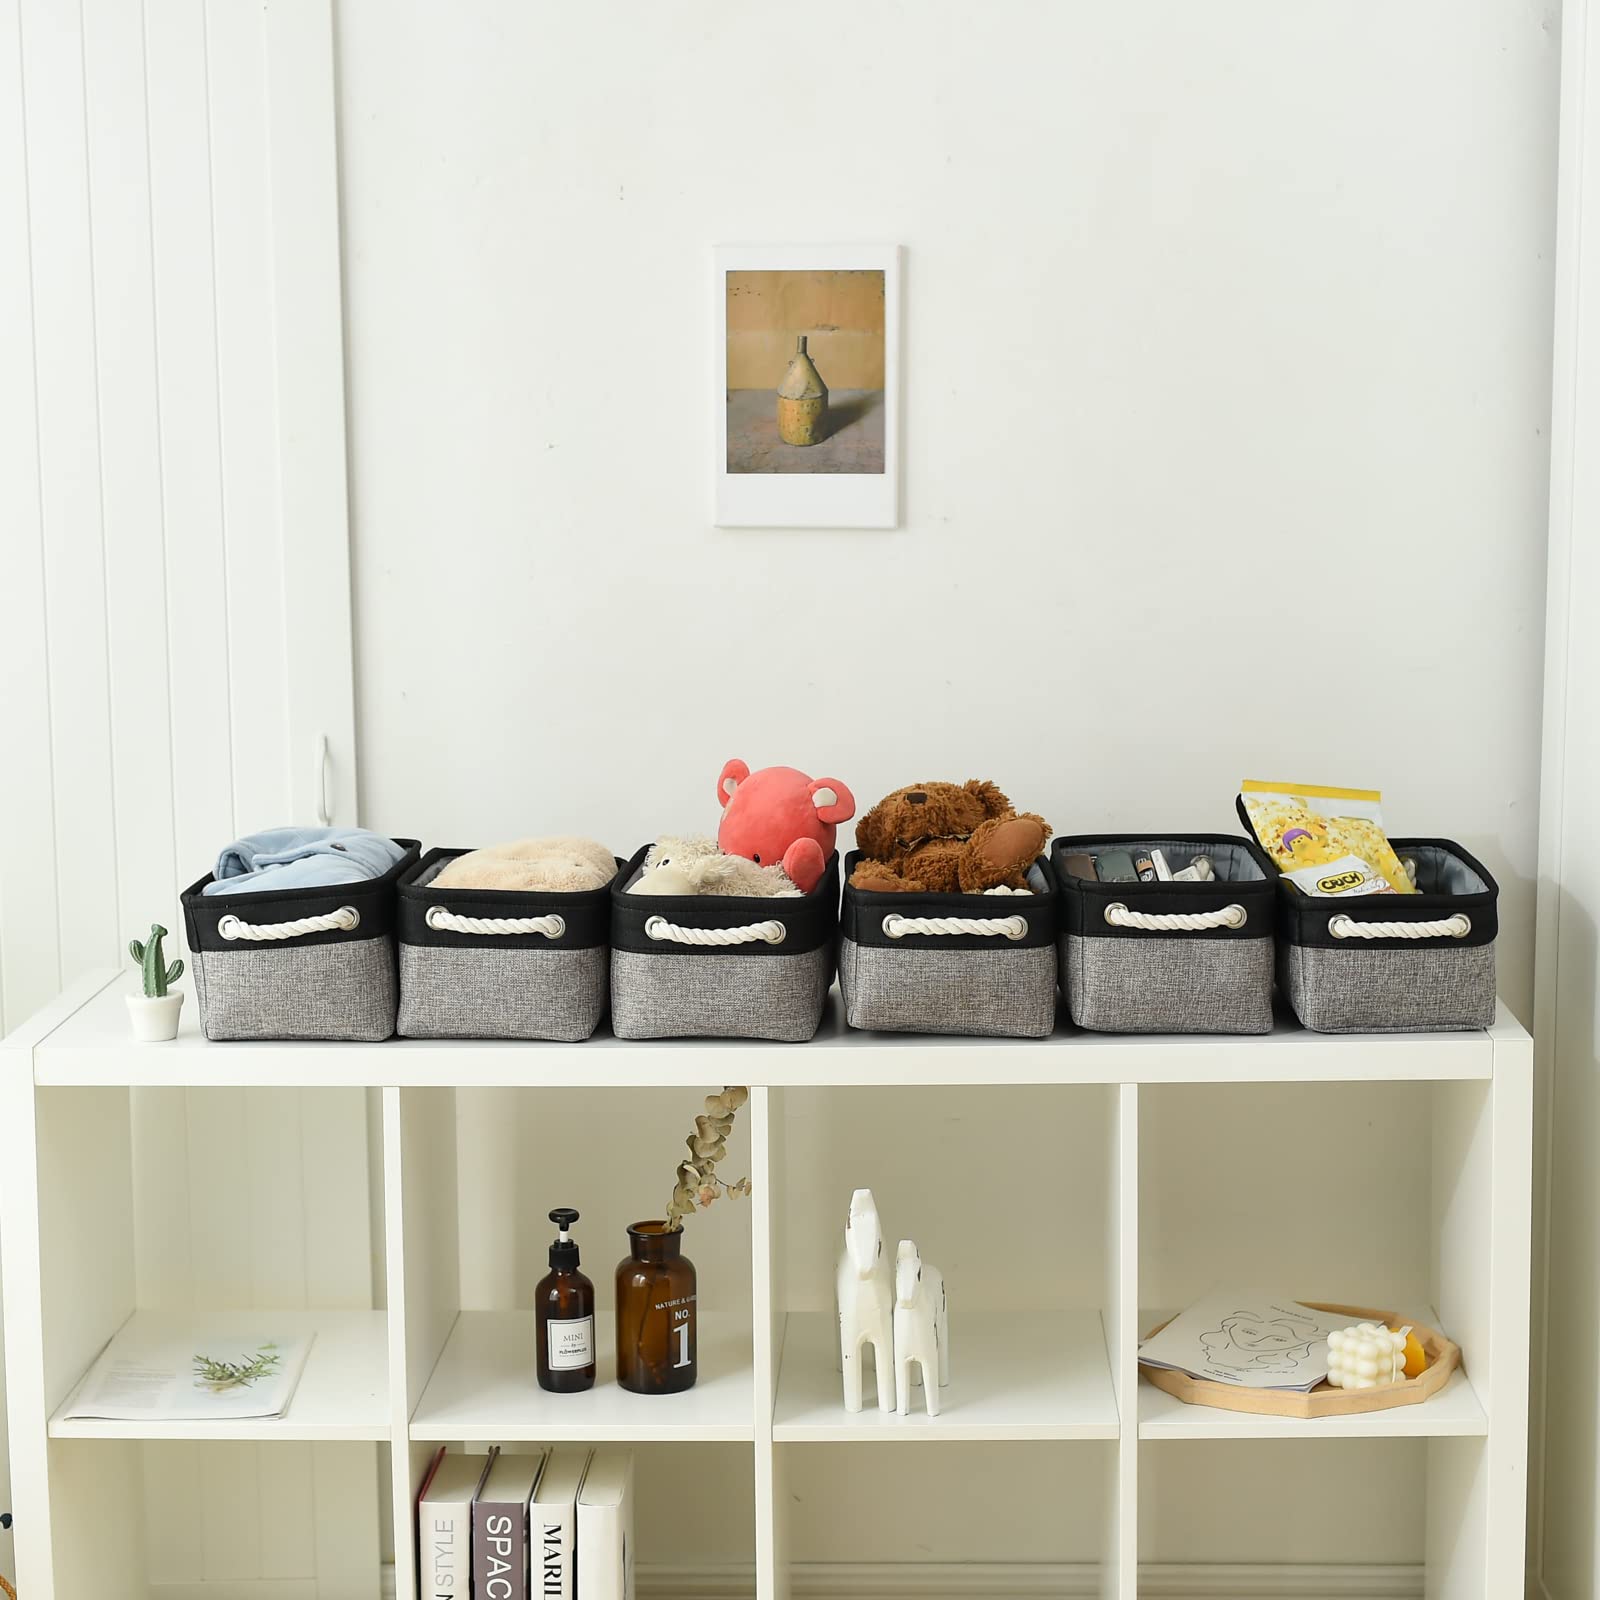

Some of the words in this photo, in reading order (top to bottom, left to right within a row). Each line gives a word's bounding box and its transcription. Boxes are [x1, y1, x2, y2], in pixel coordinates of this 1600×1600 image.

[655, 1298, 681, 1310] NATURE
[563, 1332, 584, 1342] MINI
[673, 1322, 692, 1369] 1
[435, 1519, 454, 1588] STYLE
